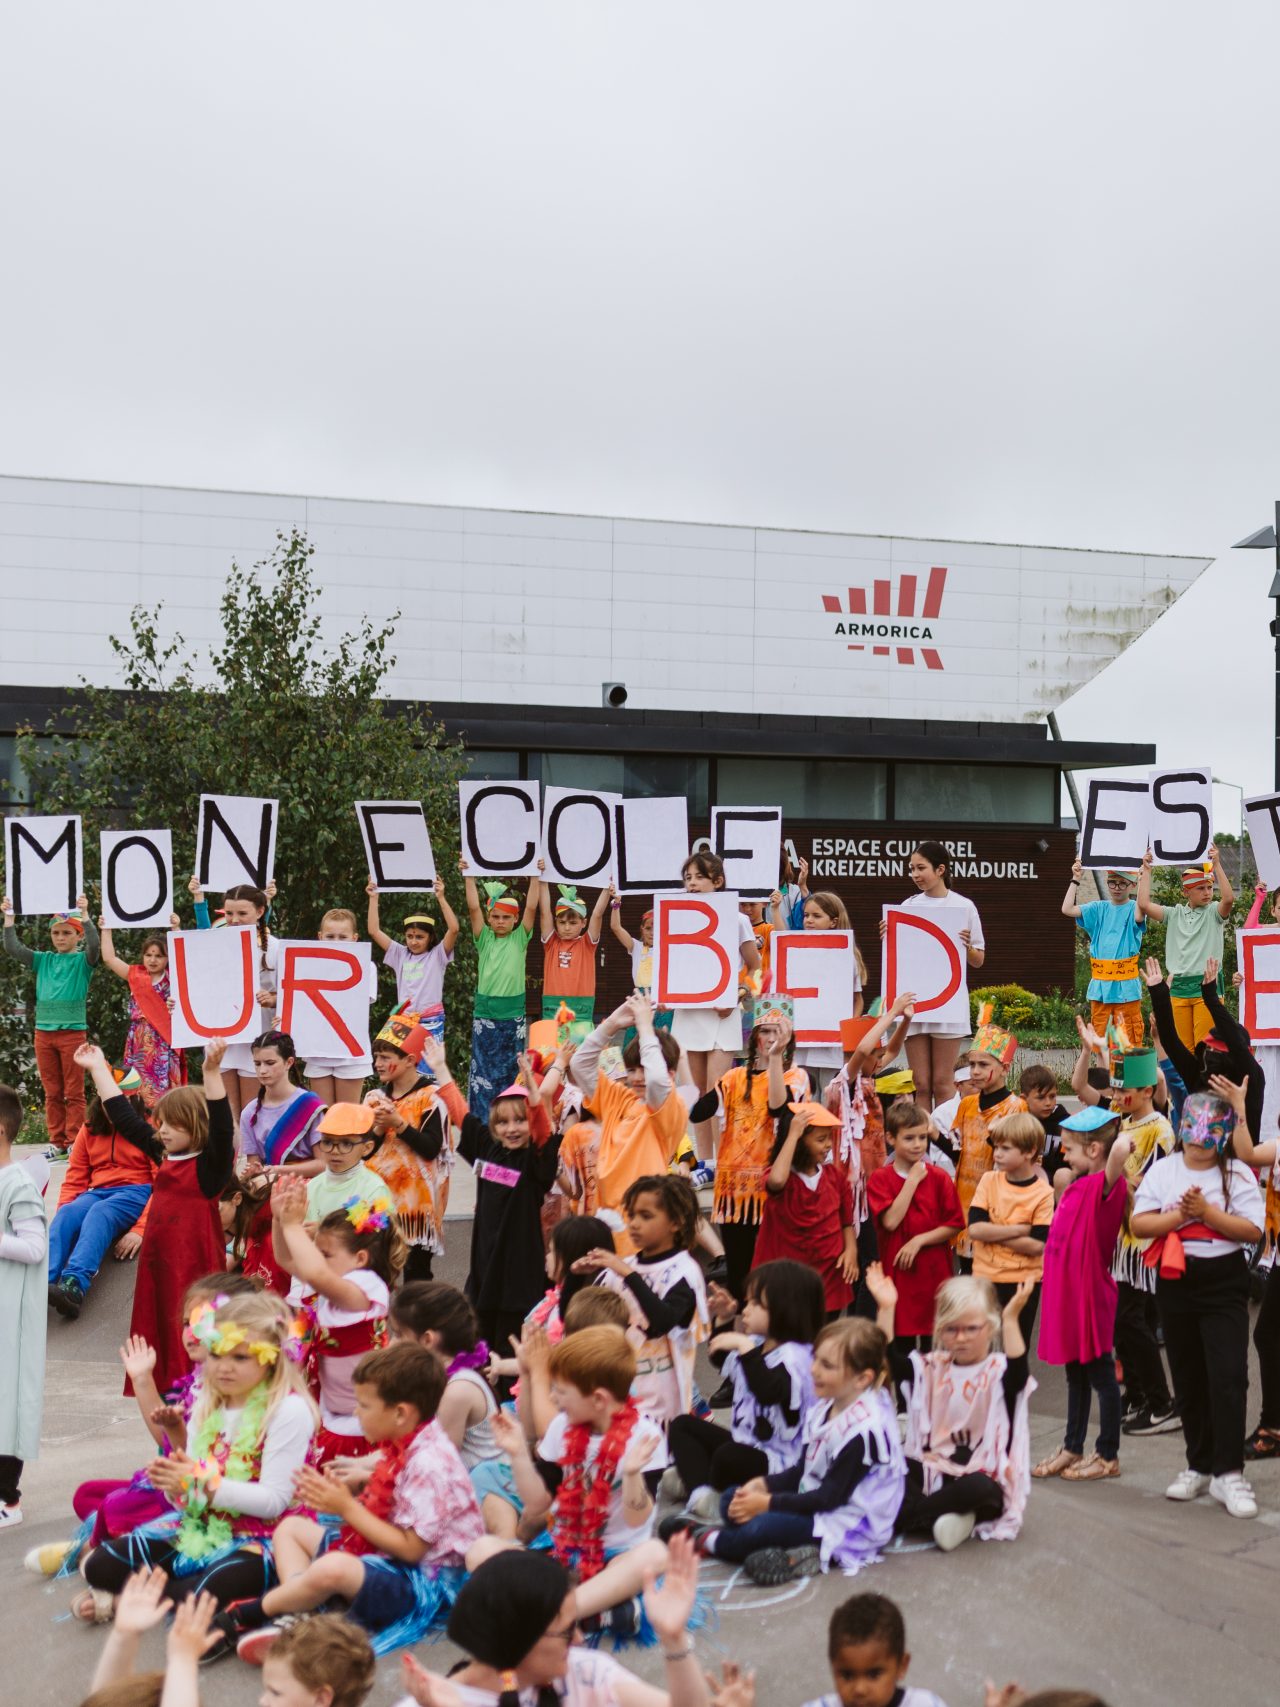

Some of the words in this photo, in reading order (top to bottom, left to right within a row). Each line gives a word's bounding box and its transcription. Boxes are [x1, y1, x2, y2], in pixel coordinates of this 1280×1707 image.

[834, 622, 933, 640] ARMORICA
[10, 800, 273, 922] MON
[361, 786, 779, 898] ECOLE
[812, 838, 881, 857] ESPACE
[812, 859, 904, 877] KREIZENN
[174, 930, 365, 1057] UR
[659, 900, 962, 1042] BED
